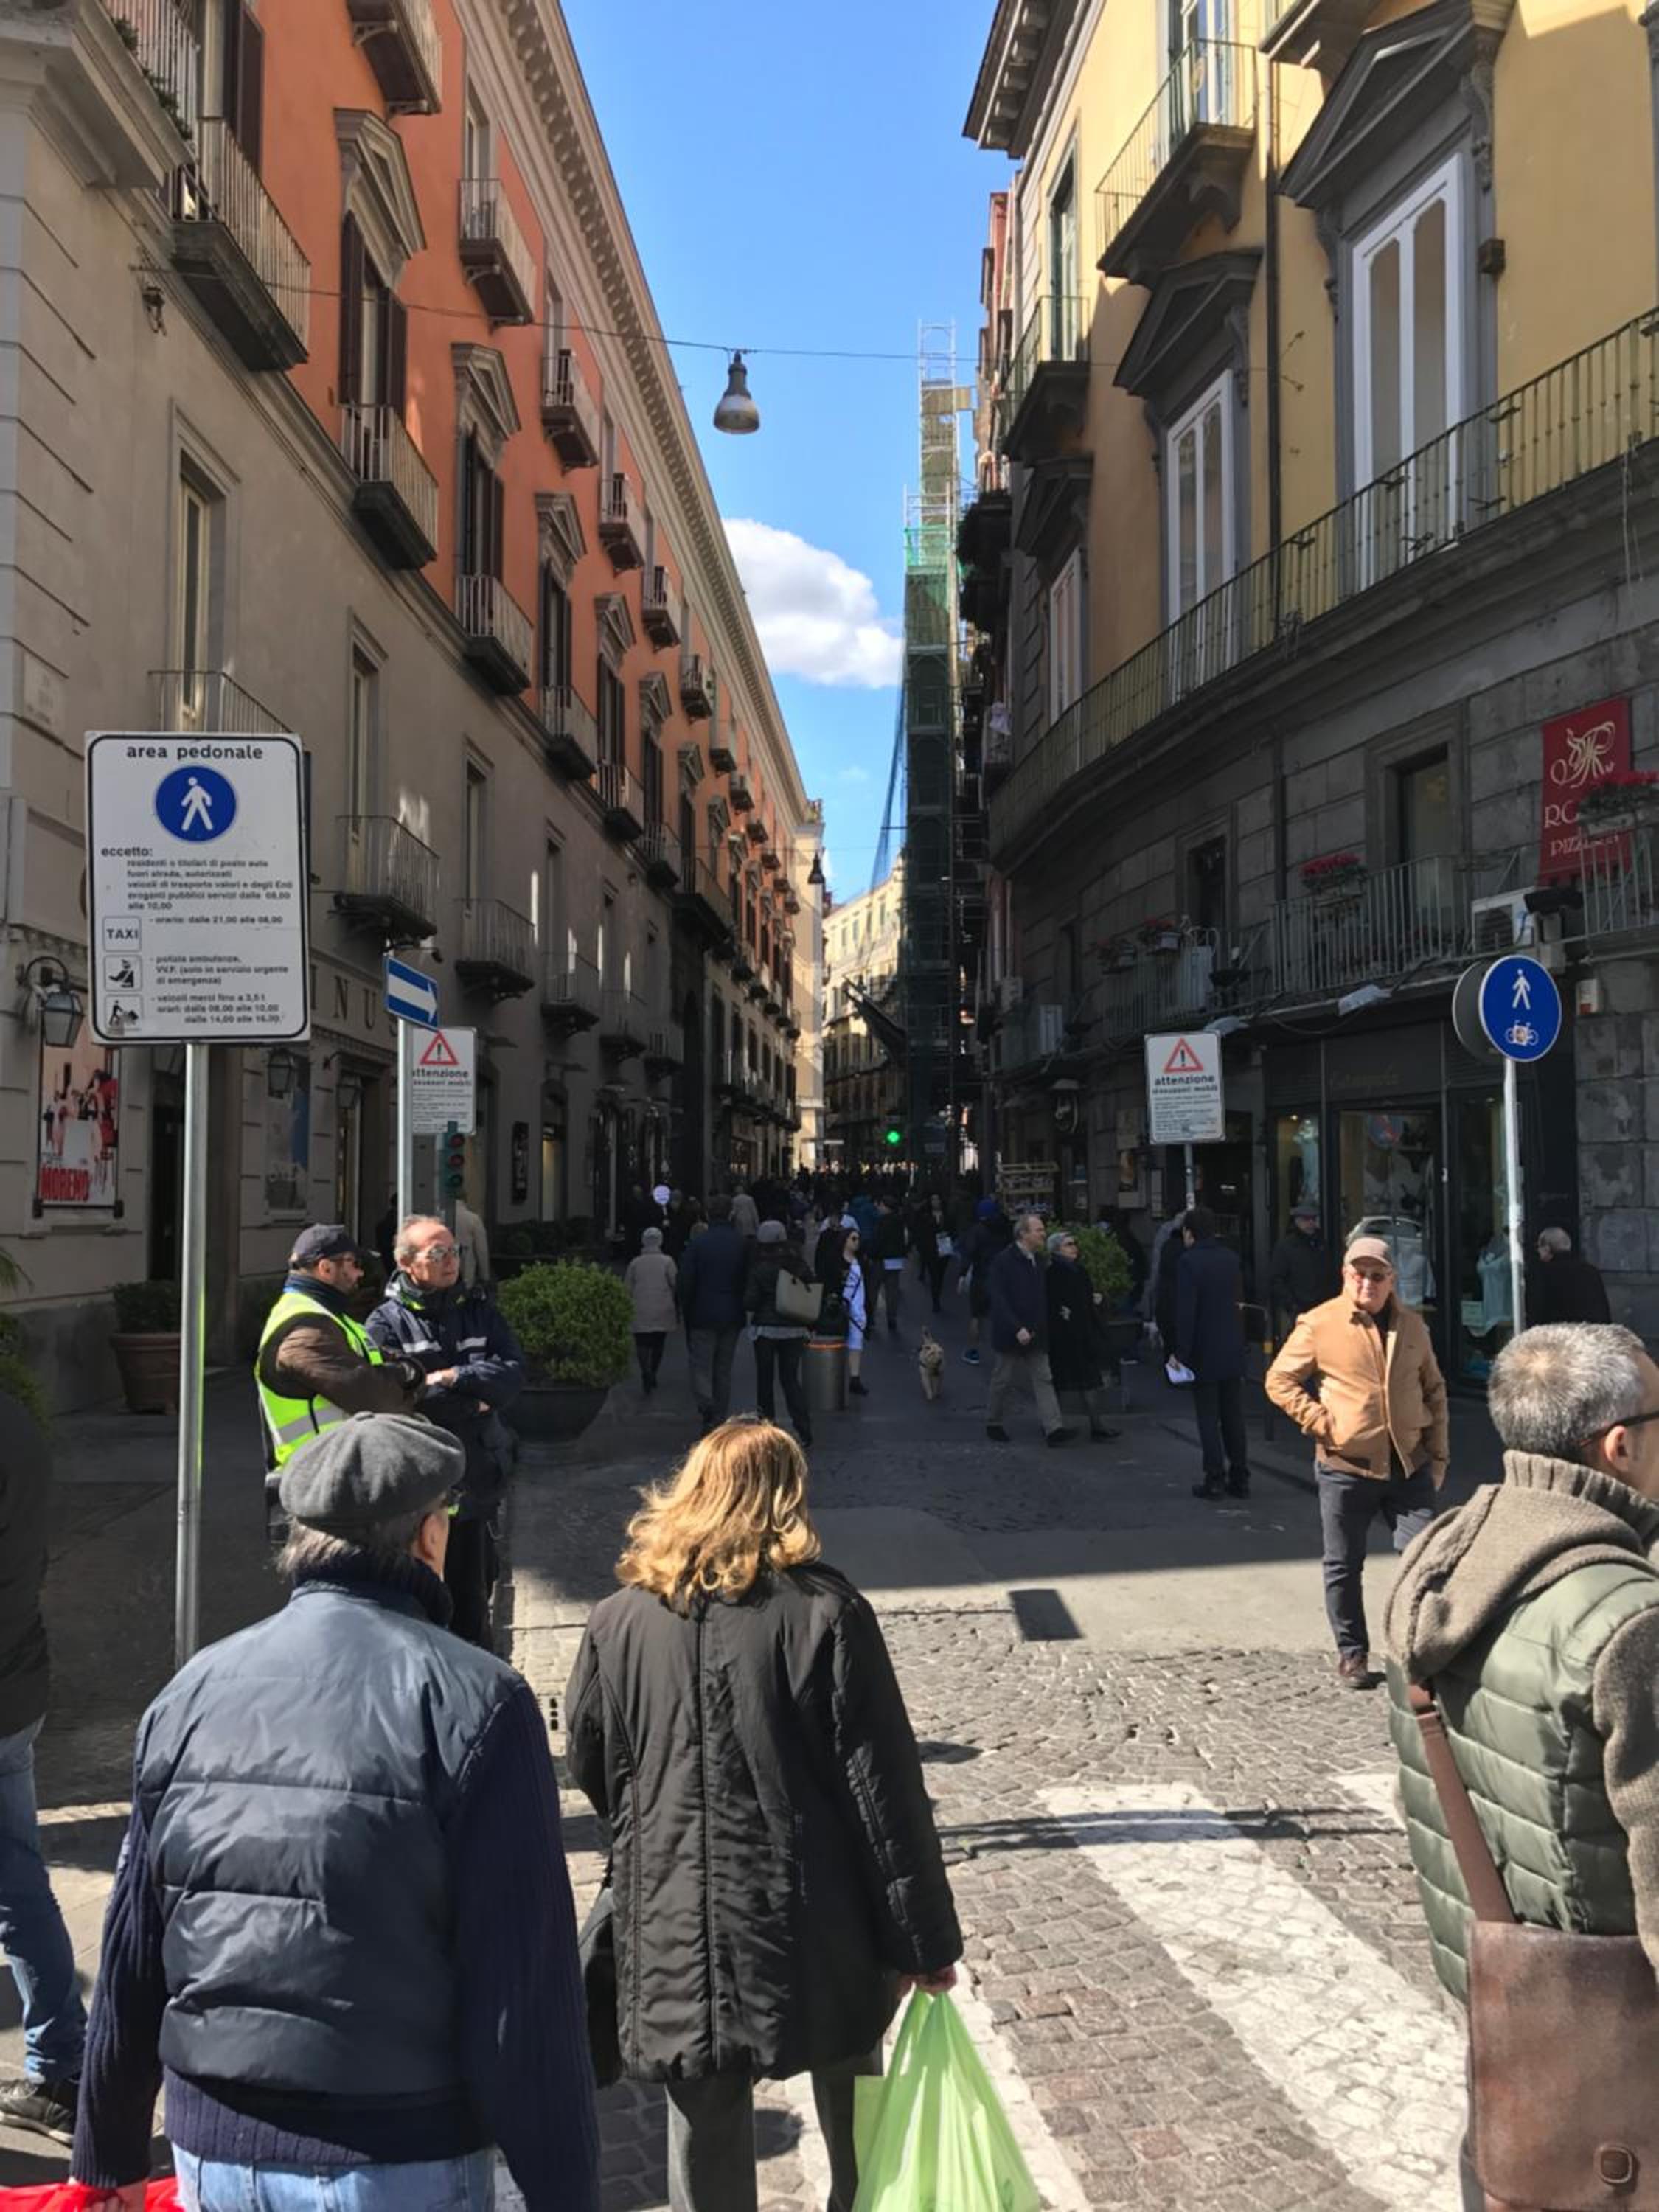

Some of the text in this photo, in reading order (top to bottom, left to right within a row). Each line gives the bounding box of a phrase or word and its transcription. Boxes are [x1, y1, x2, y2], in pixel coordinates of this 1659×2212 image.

[126, 745, 264, 761] area pedonale
[101, 846, 153, 857] eccetto:
[106, 928, 139, 940] TAXI
[1155, 1075, 1215, 1086] attenzione
